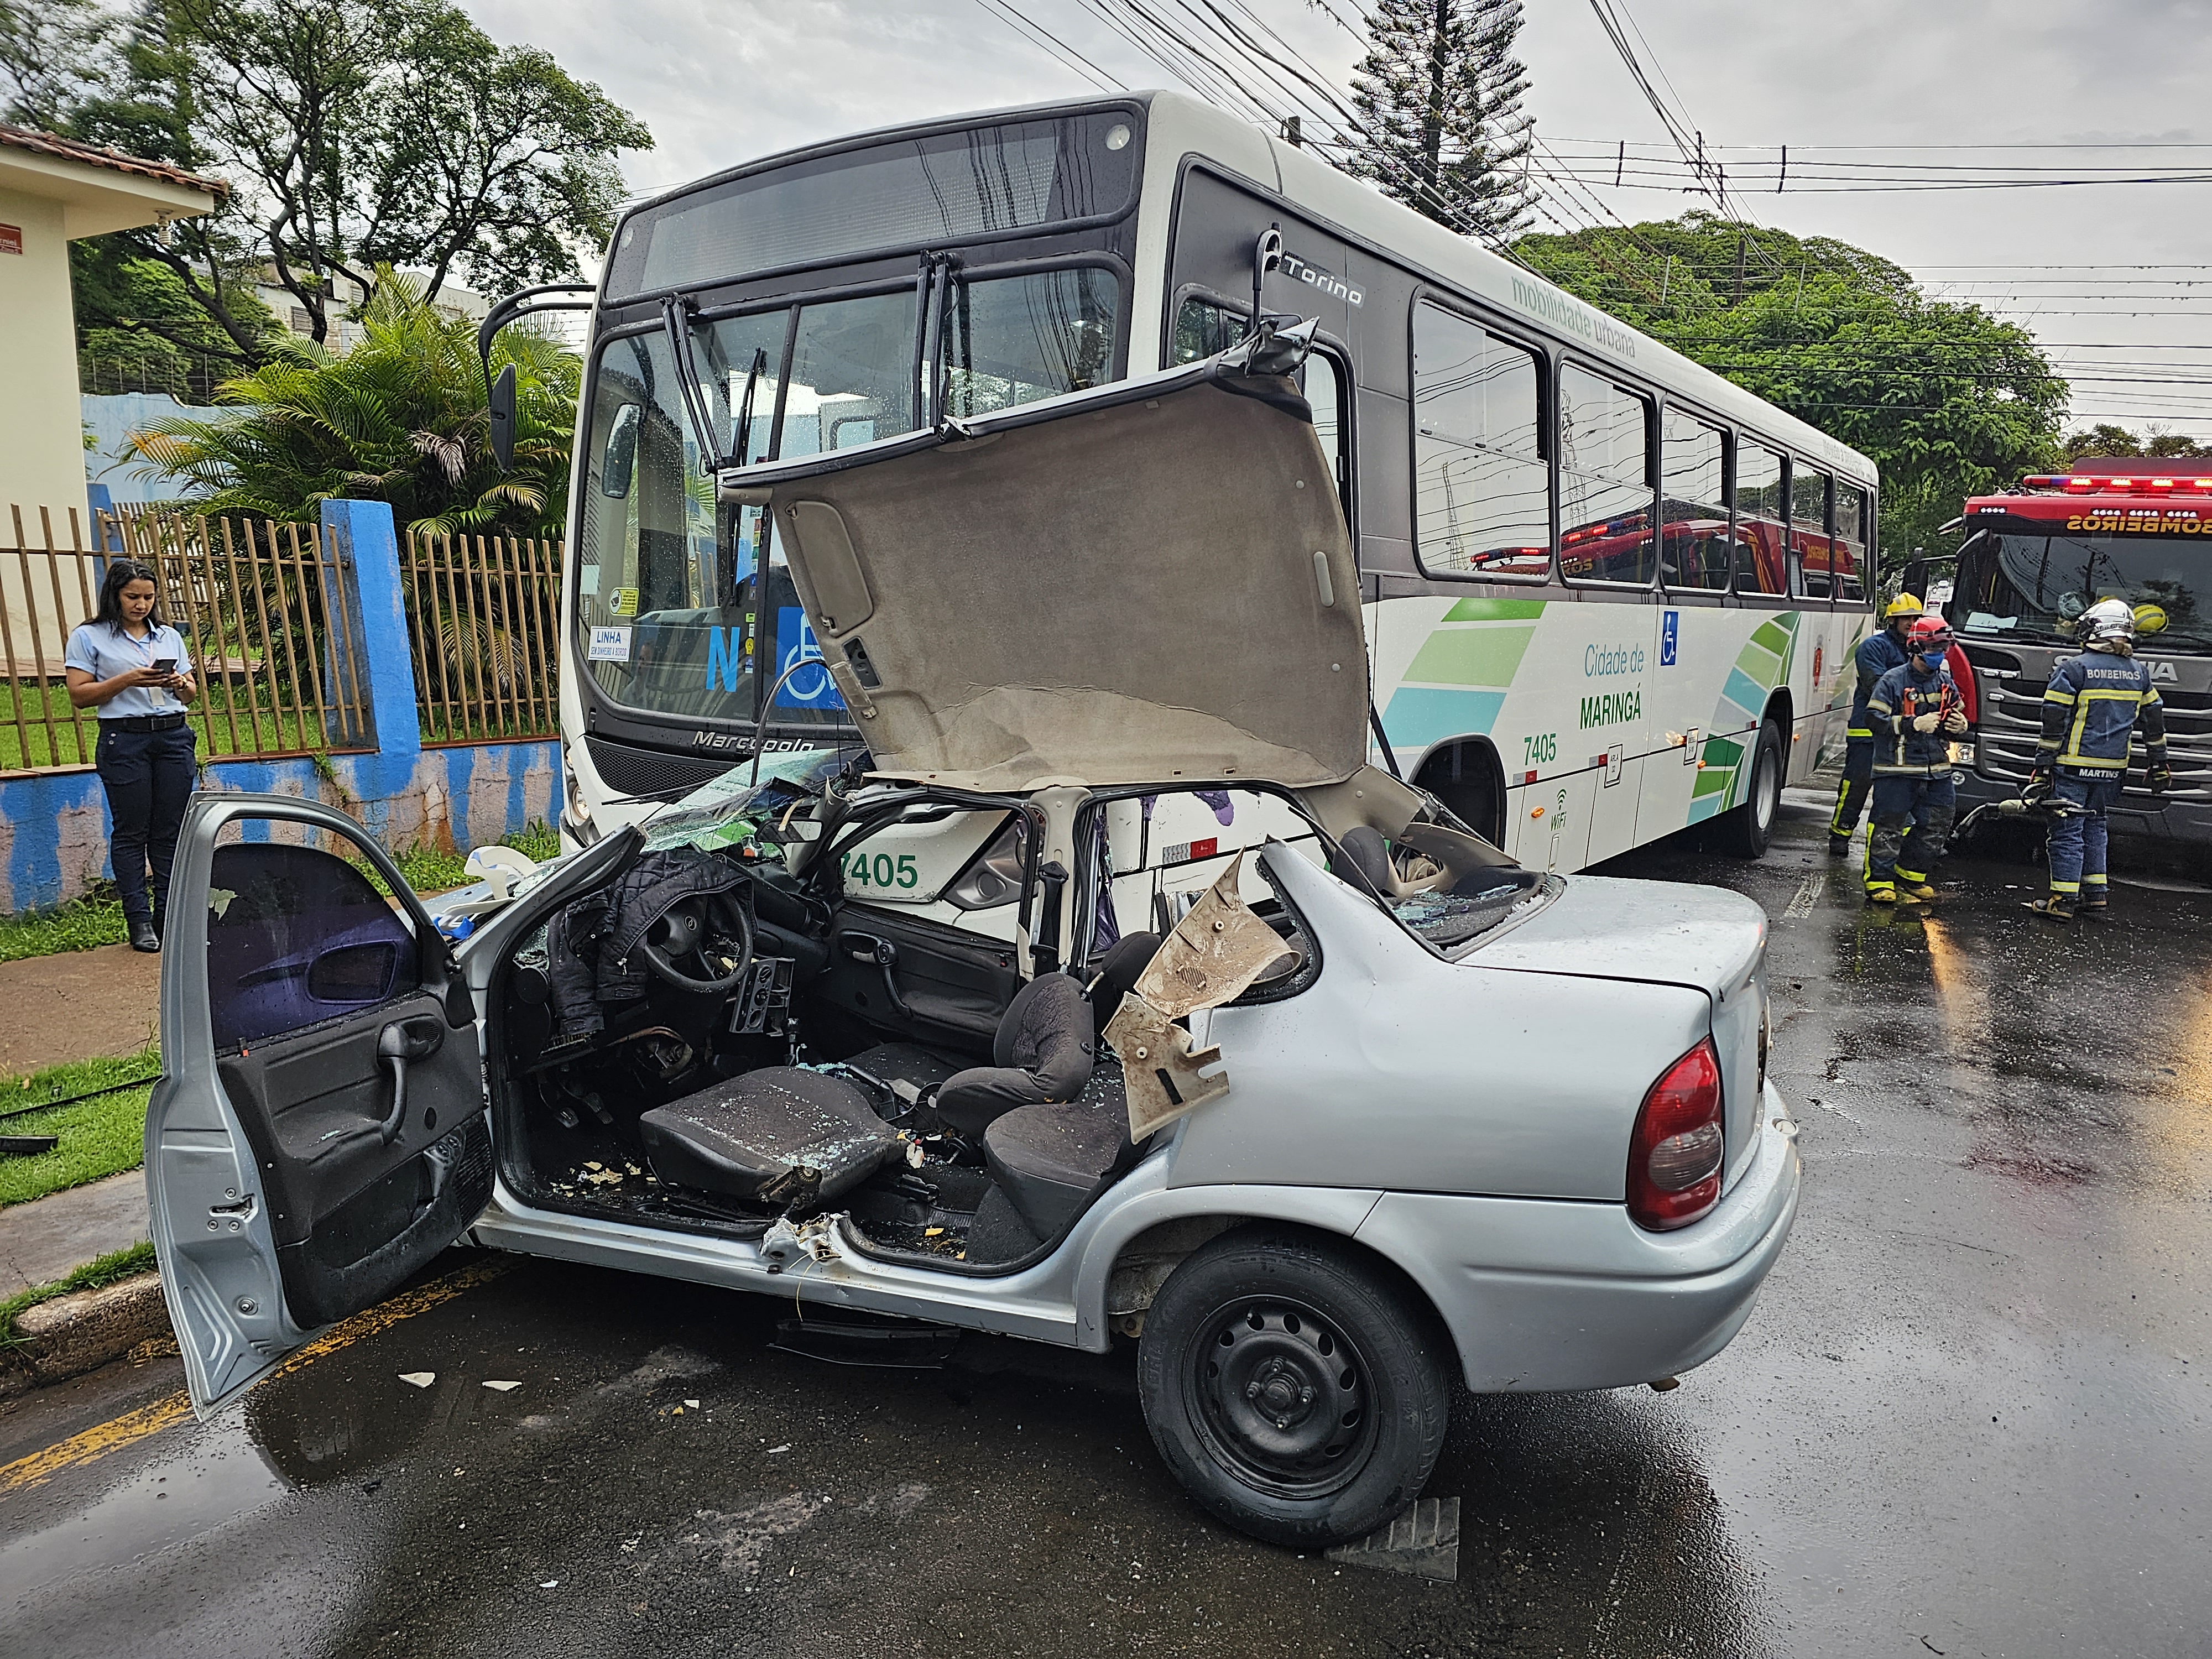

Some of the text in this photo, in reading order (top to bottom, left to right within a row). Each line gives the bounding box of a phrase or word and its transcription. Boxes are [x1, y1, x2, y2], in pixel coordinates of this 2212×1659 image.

[1285, 255, 1361, 304] Torino
[1511, 276, 1635, 358] mobilidade urbana
[597, 631, 621, 644] LINHA
[706, 625, 740, 692] N
[1585, 643, 1644, 677] Cidade de
[2086, 669, 2140, 681] BOMBEIROS
[1580, 682, 1641, 729] MARINGÁ
[1525, 733, 1556, 765] 7405
[2079, 768, 2120, 779] MARTINS
[1551, 811, 1567, 831] WiFi
